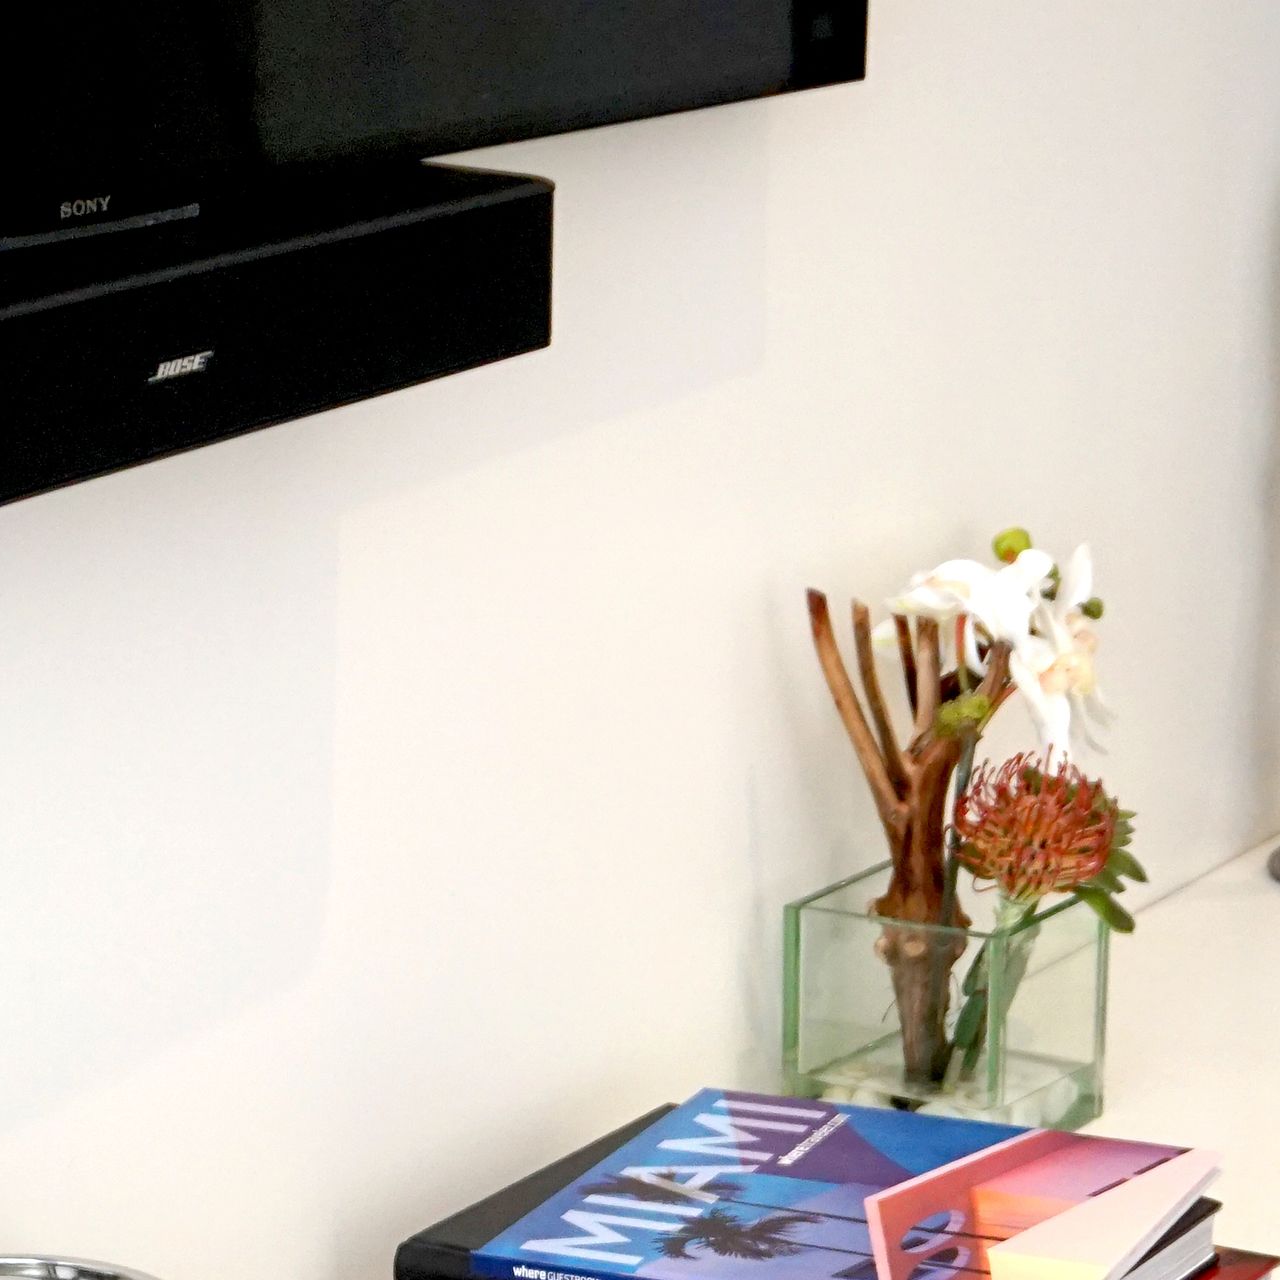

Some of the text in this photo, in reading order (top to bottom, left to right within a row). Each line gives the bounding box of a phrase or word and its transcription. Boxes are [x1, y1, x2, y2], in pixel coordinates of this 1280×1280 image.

[60, 195, 111, 220] SONY
[148, 350, 215, 384] BOSE
[519, 1098, 828, 1265] MIAMI
[512, 1264, 547, 1280] where
